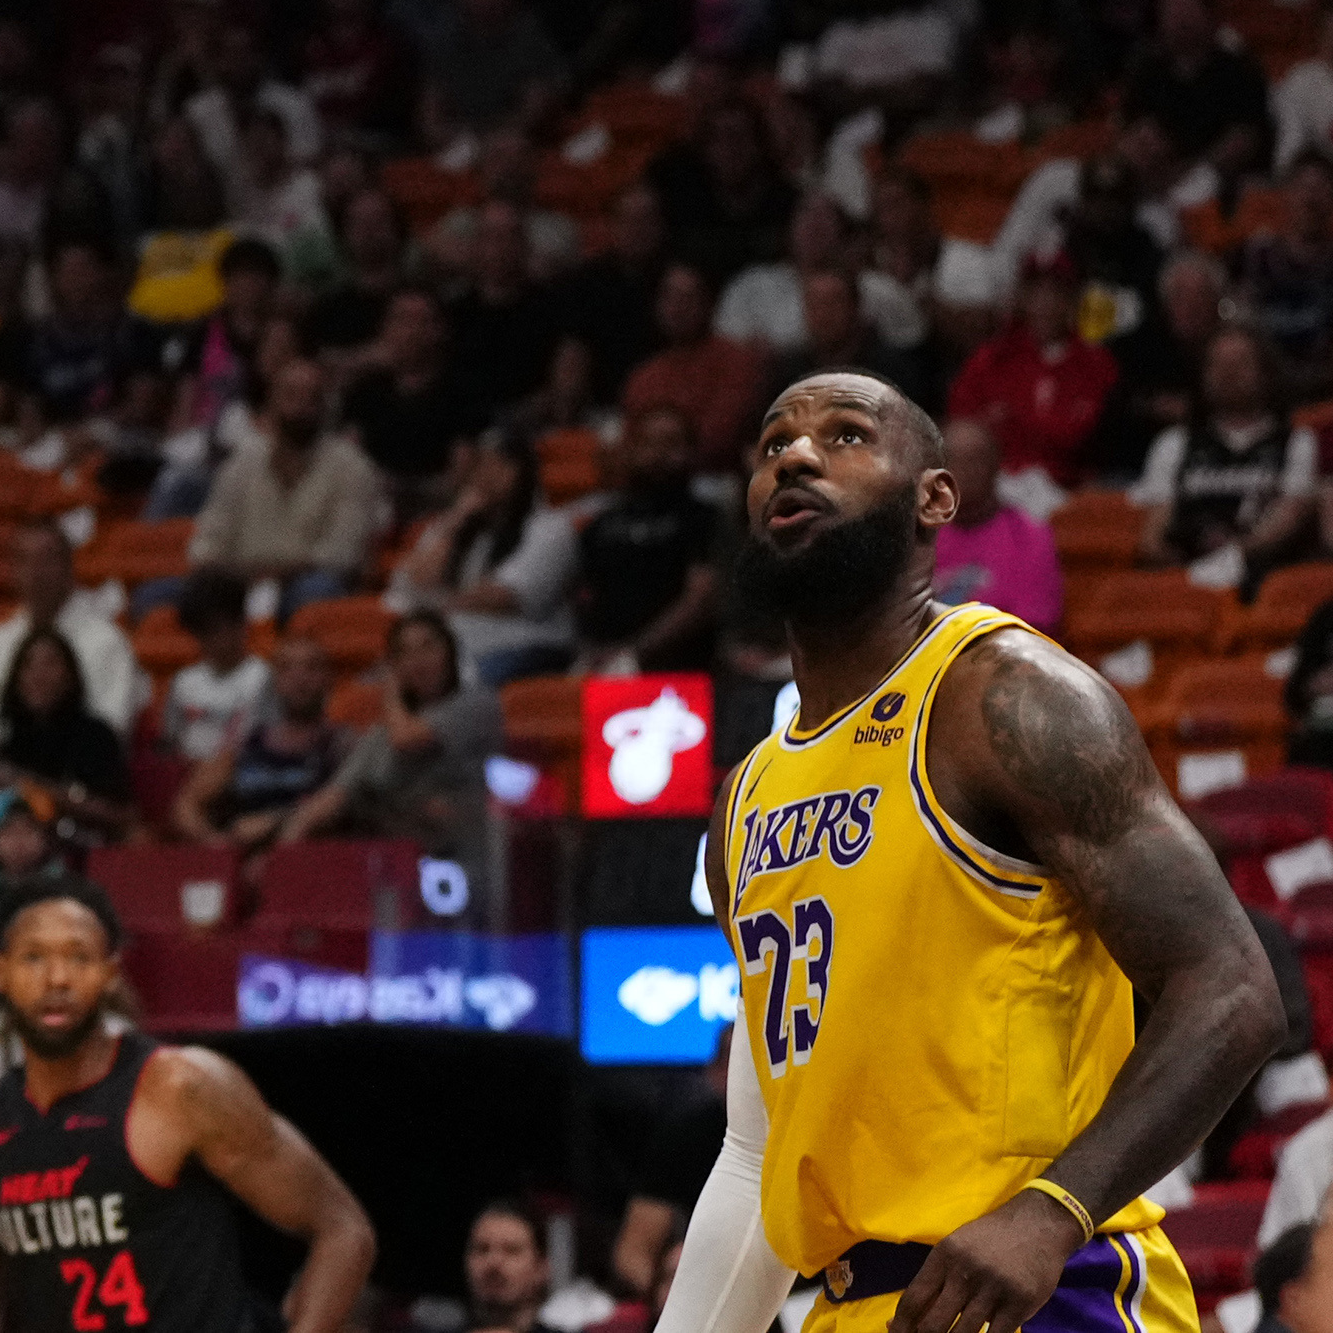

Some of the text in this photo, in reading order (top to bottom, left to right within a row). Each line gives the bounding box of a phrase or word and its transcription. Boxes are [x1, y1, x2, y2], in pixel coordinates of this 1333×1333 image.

[854, 725, 904, 747] bibigo
[733, 785, 882, 921] LAKERS
[734, 894, 834, 1080] 23
[0, 1155, 91, 1206] HEAT
[60, 1249, 148, 1332] 24
